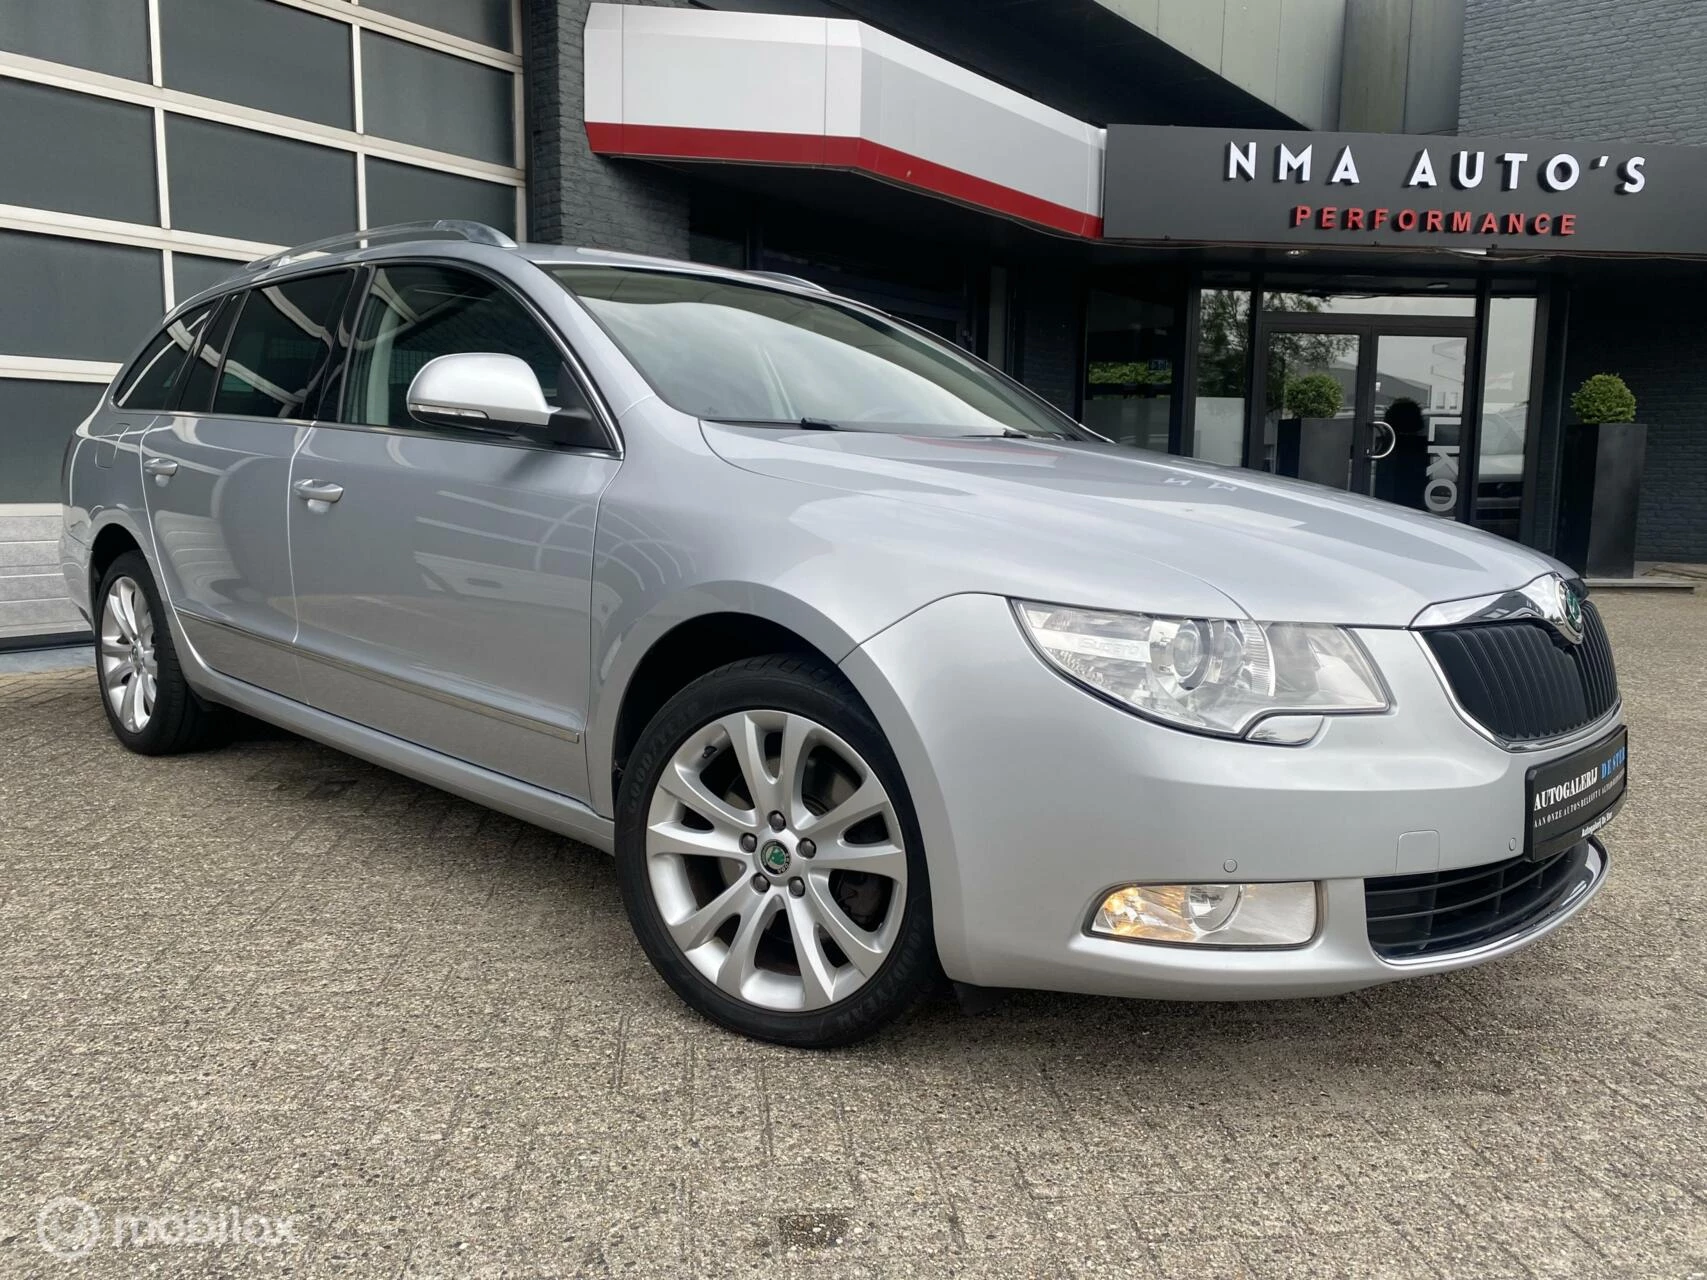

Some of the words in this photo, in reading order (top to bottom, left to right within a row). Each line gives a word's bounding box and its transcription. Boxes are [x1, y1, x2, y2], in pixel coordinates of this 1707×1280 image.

[1228, 141, 1360, 185] NMA
[1408, 148, 1647, 194] AUTO'S
[1295, 204, 1578, 236] PERFORMANCE
[1534, 767, 1599, 811] AUTOGALERIJ
